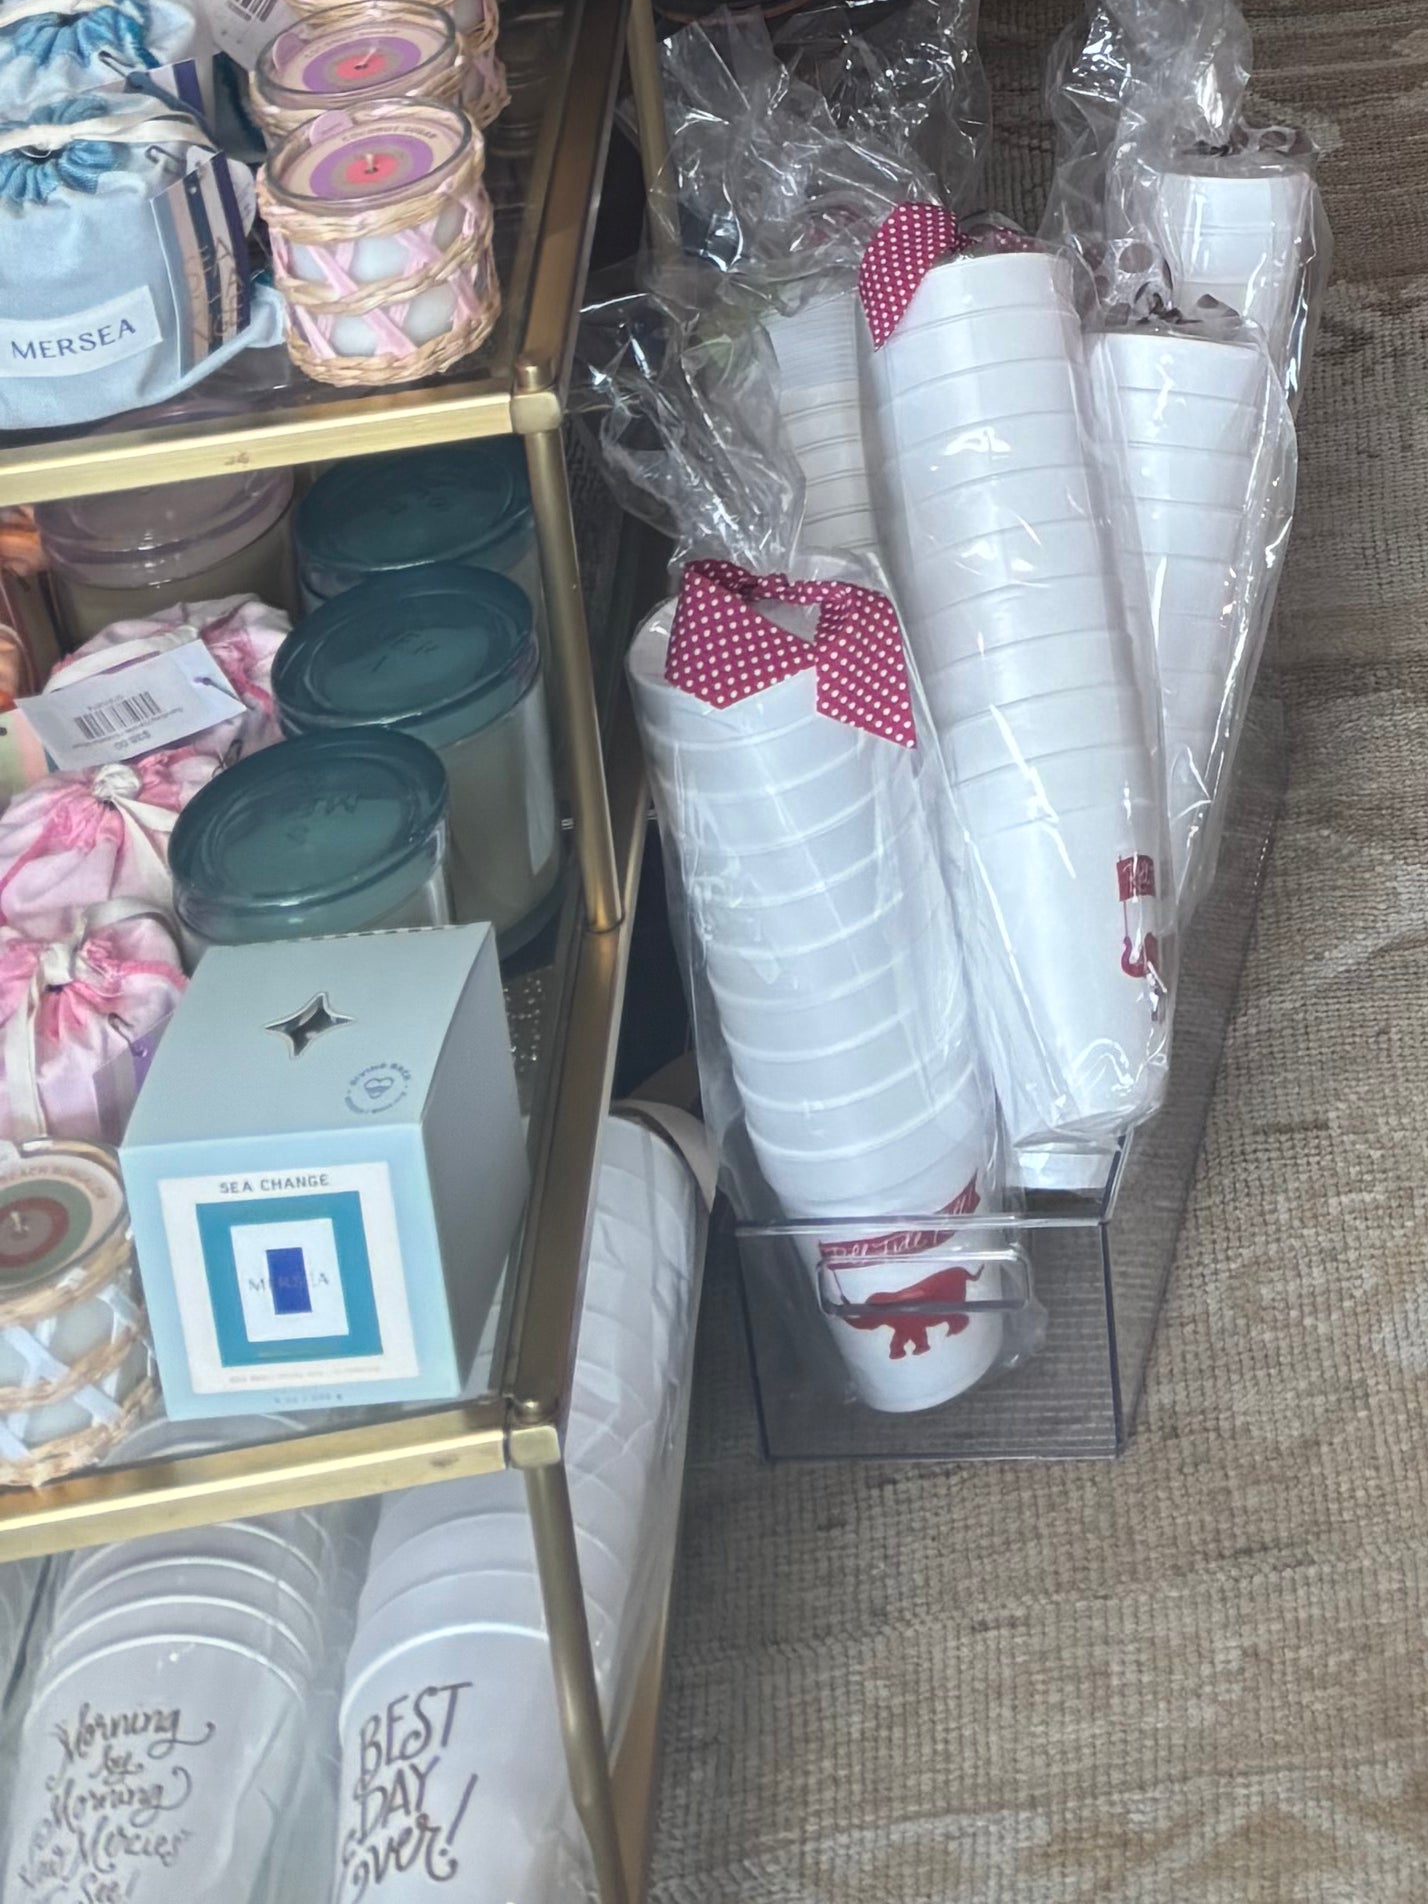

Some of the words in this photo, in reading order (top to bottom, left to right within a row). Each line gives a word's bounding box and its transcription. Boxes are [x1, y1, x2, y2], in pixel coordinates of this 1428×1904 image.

[11, 318, 136, 360] MERSEA
[220, 1181, 252, 1194] SEA
[260, 1174, 330, 1192] CHANGE
[354, 1681, 474, 1800] BEST
[358, 1755, 441, 1845] DAY
